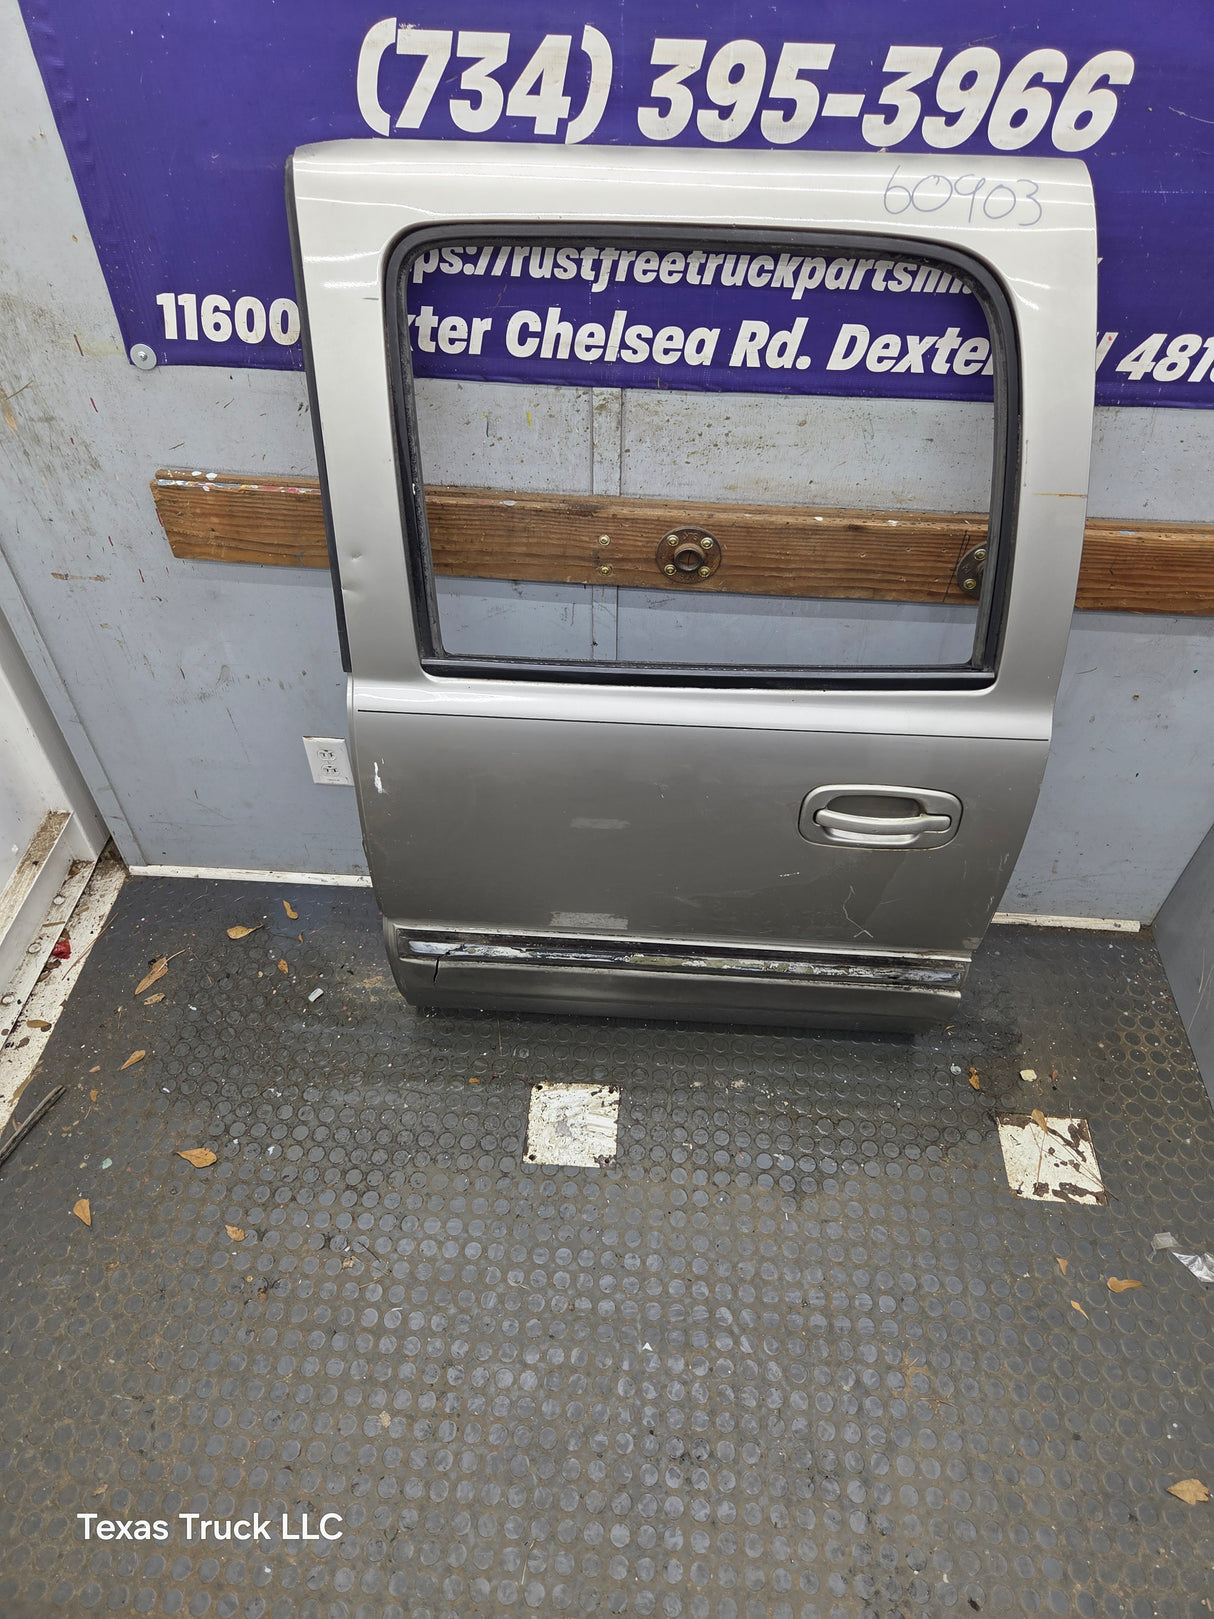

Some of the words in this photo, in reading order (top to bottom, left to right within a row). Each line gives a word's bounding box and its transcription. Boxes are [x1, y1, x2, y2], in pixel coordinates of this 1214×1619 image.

[357, 17, 613, 144] (734)
[637, 38, 1135, 152] 395-3966
[883, 165, 1043, 227] 60903
[156, 292, 301, 346] 11600
[407, 306, 493, 355] ter
[505, 306, 720, 367] Chelsea
[728, 317, 812, 370] Rd.
[825, 322, 994, 376] Dexte
[1114, 333, 1214, 383] 481
